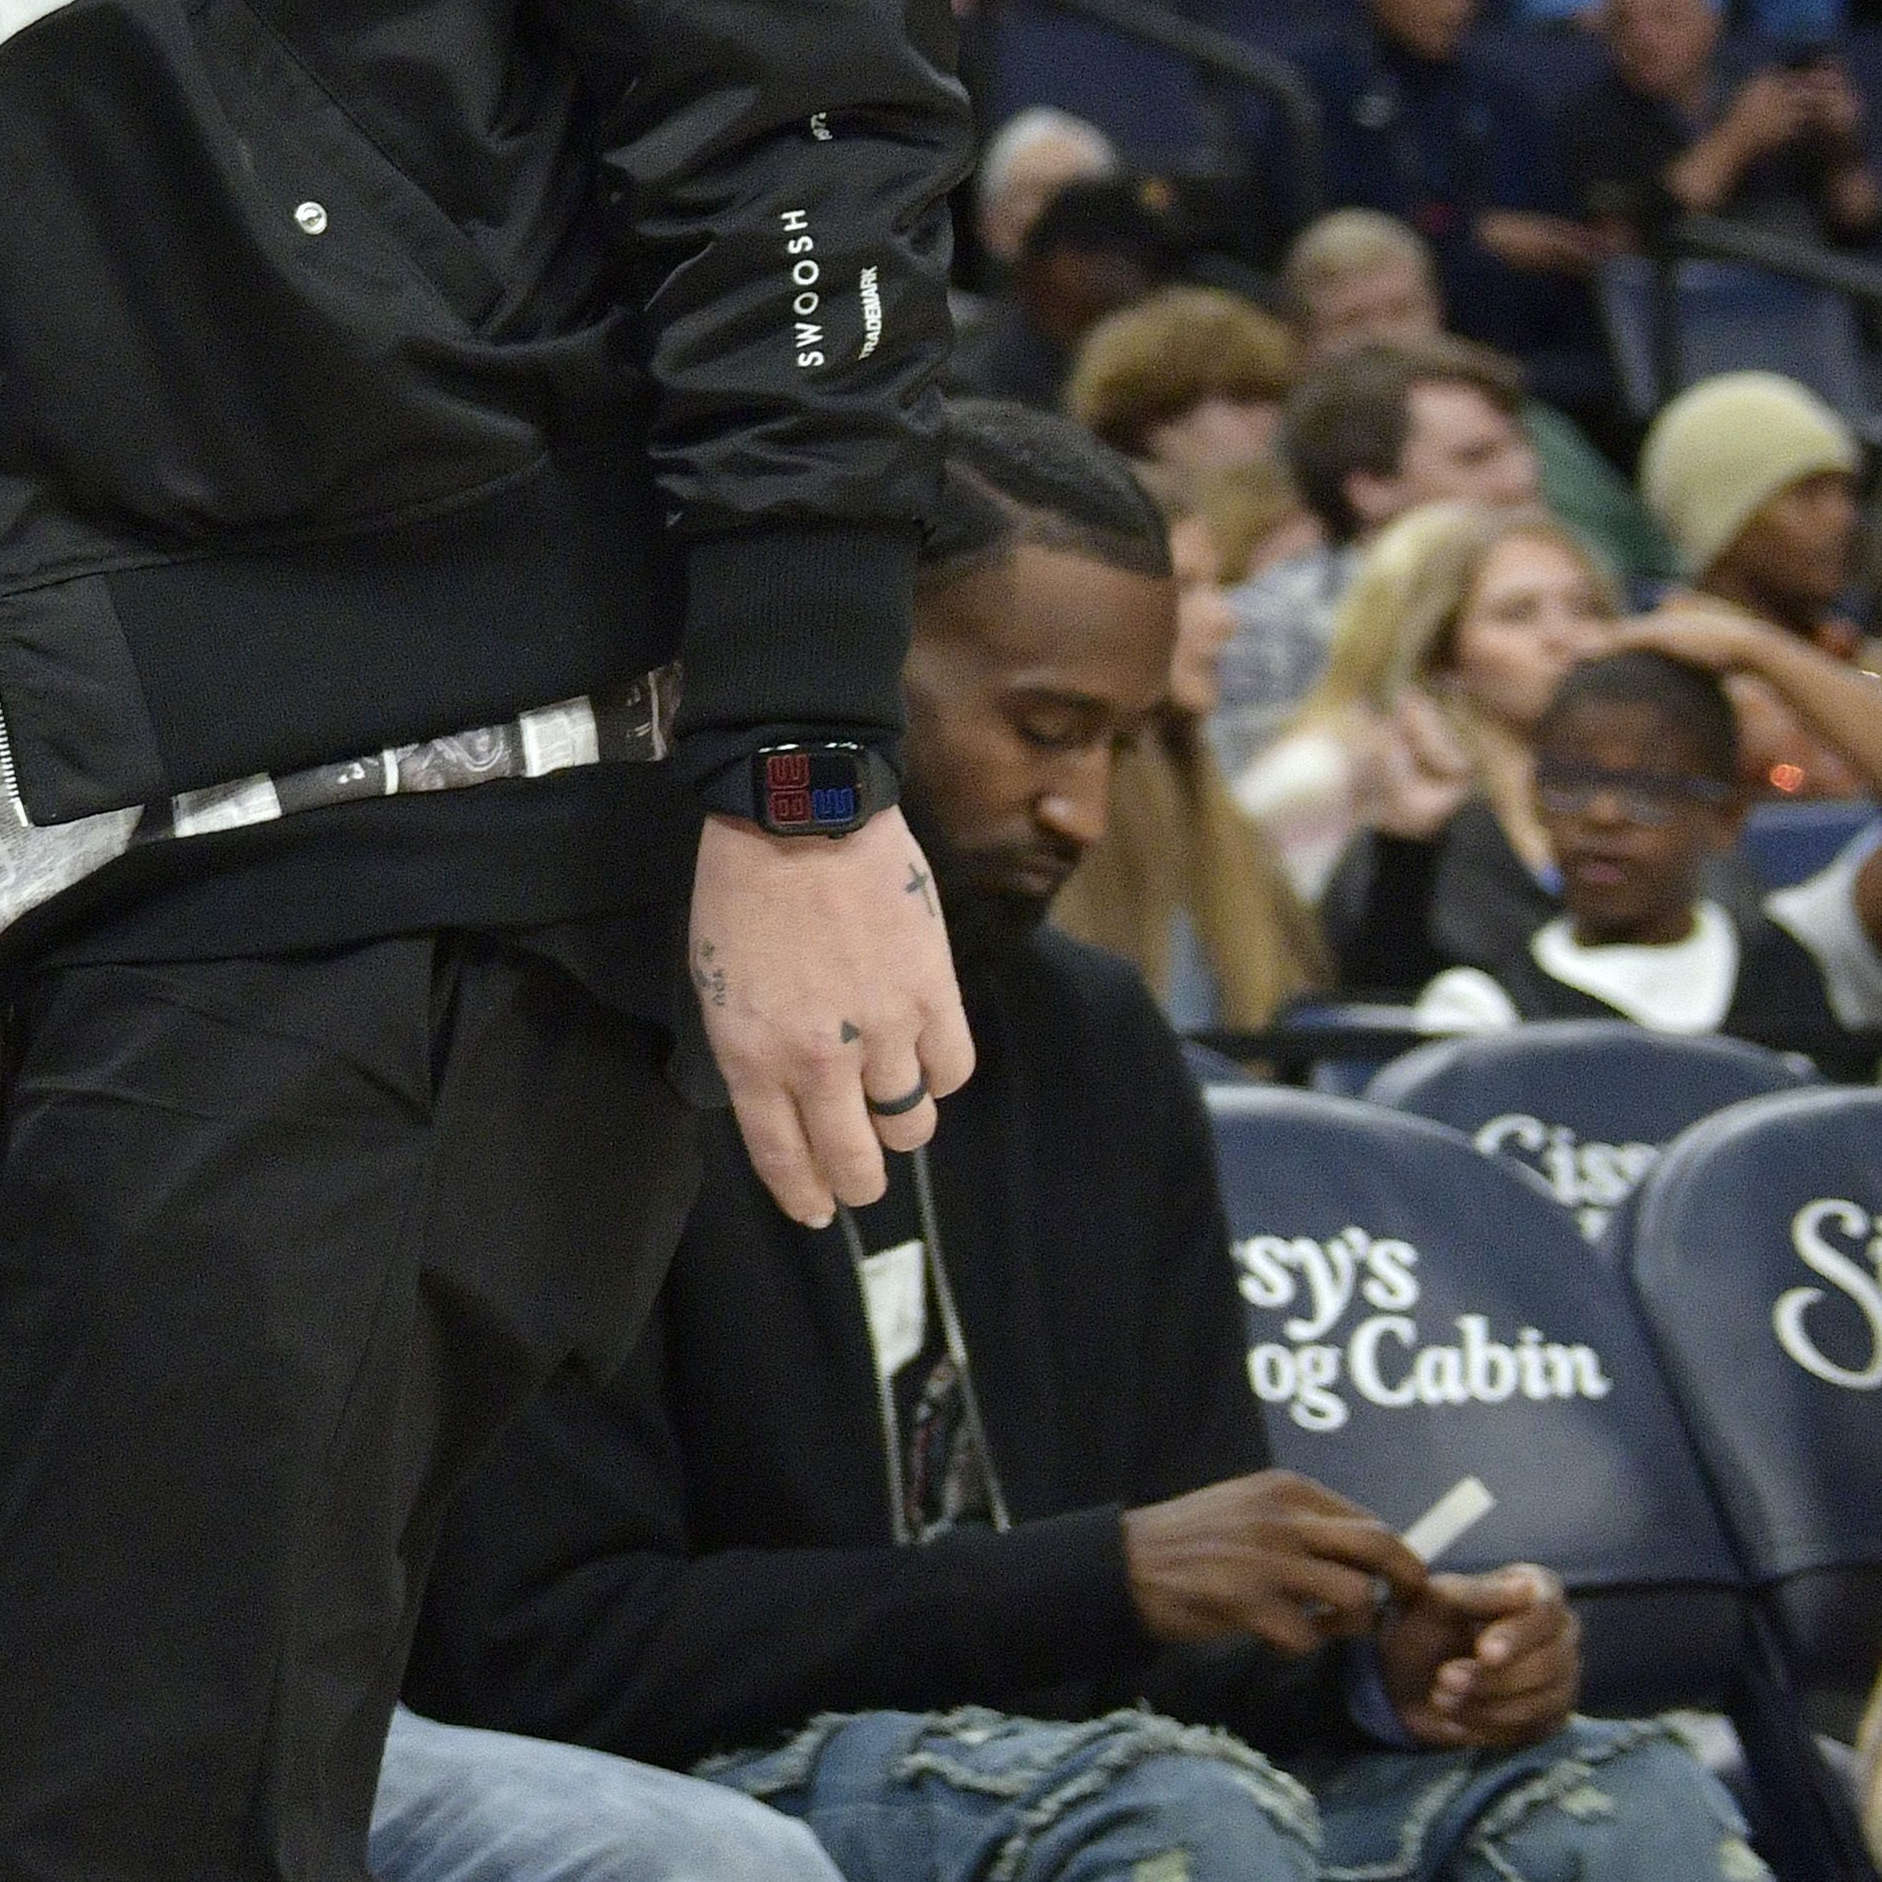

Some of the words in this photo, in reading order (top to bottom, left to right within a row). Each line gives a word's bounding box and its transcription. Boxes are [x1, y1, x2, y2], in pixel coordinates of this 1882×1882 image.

[781, 209, 825, 367] SWOOSH
[858, 265, 882, 360] TRADEMARK
[1232, 1226, 1422, 1342] sy's
[1348, 1313, 1615, 1408] Cabin
